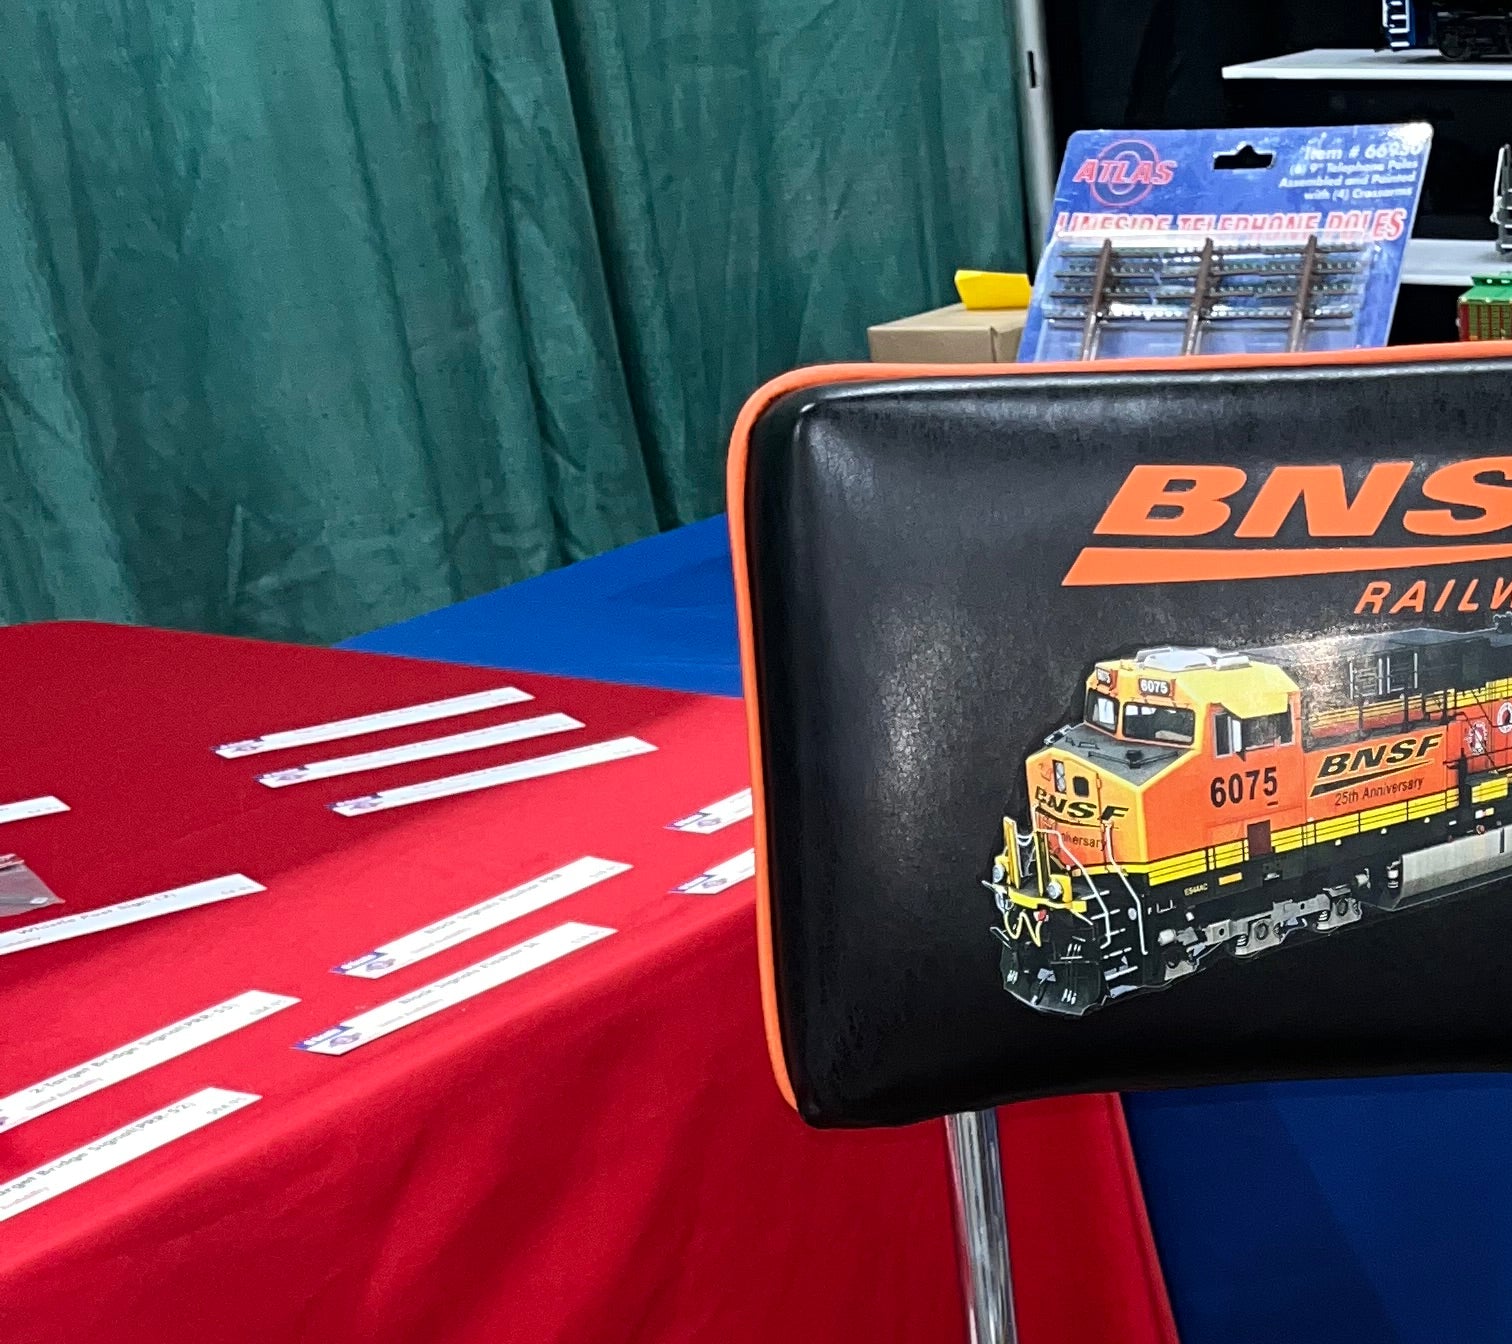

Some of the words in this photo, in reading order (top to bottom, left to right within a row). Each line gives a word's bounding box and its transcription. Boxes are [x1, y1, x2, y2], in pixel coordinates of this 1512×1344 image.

[1073, 159, 1178, 185] ATLAS
[1279, 175, 1343, 188] Assembled
[1345, 174, 1370, 186] and
[1140, 679, 1168, 694] 6075
[1317, 733, 1443, 778] BNSF
[1035, 785, 1130, 820] BNSF
[1210, 767, 1278, 808] 6075
[1335, 791, 1359, 806] 25th
[1362, 776, 1424, 800] Anniversary
